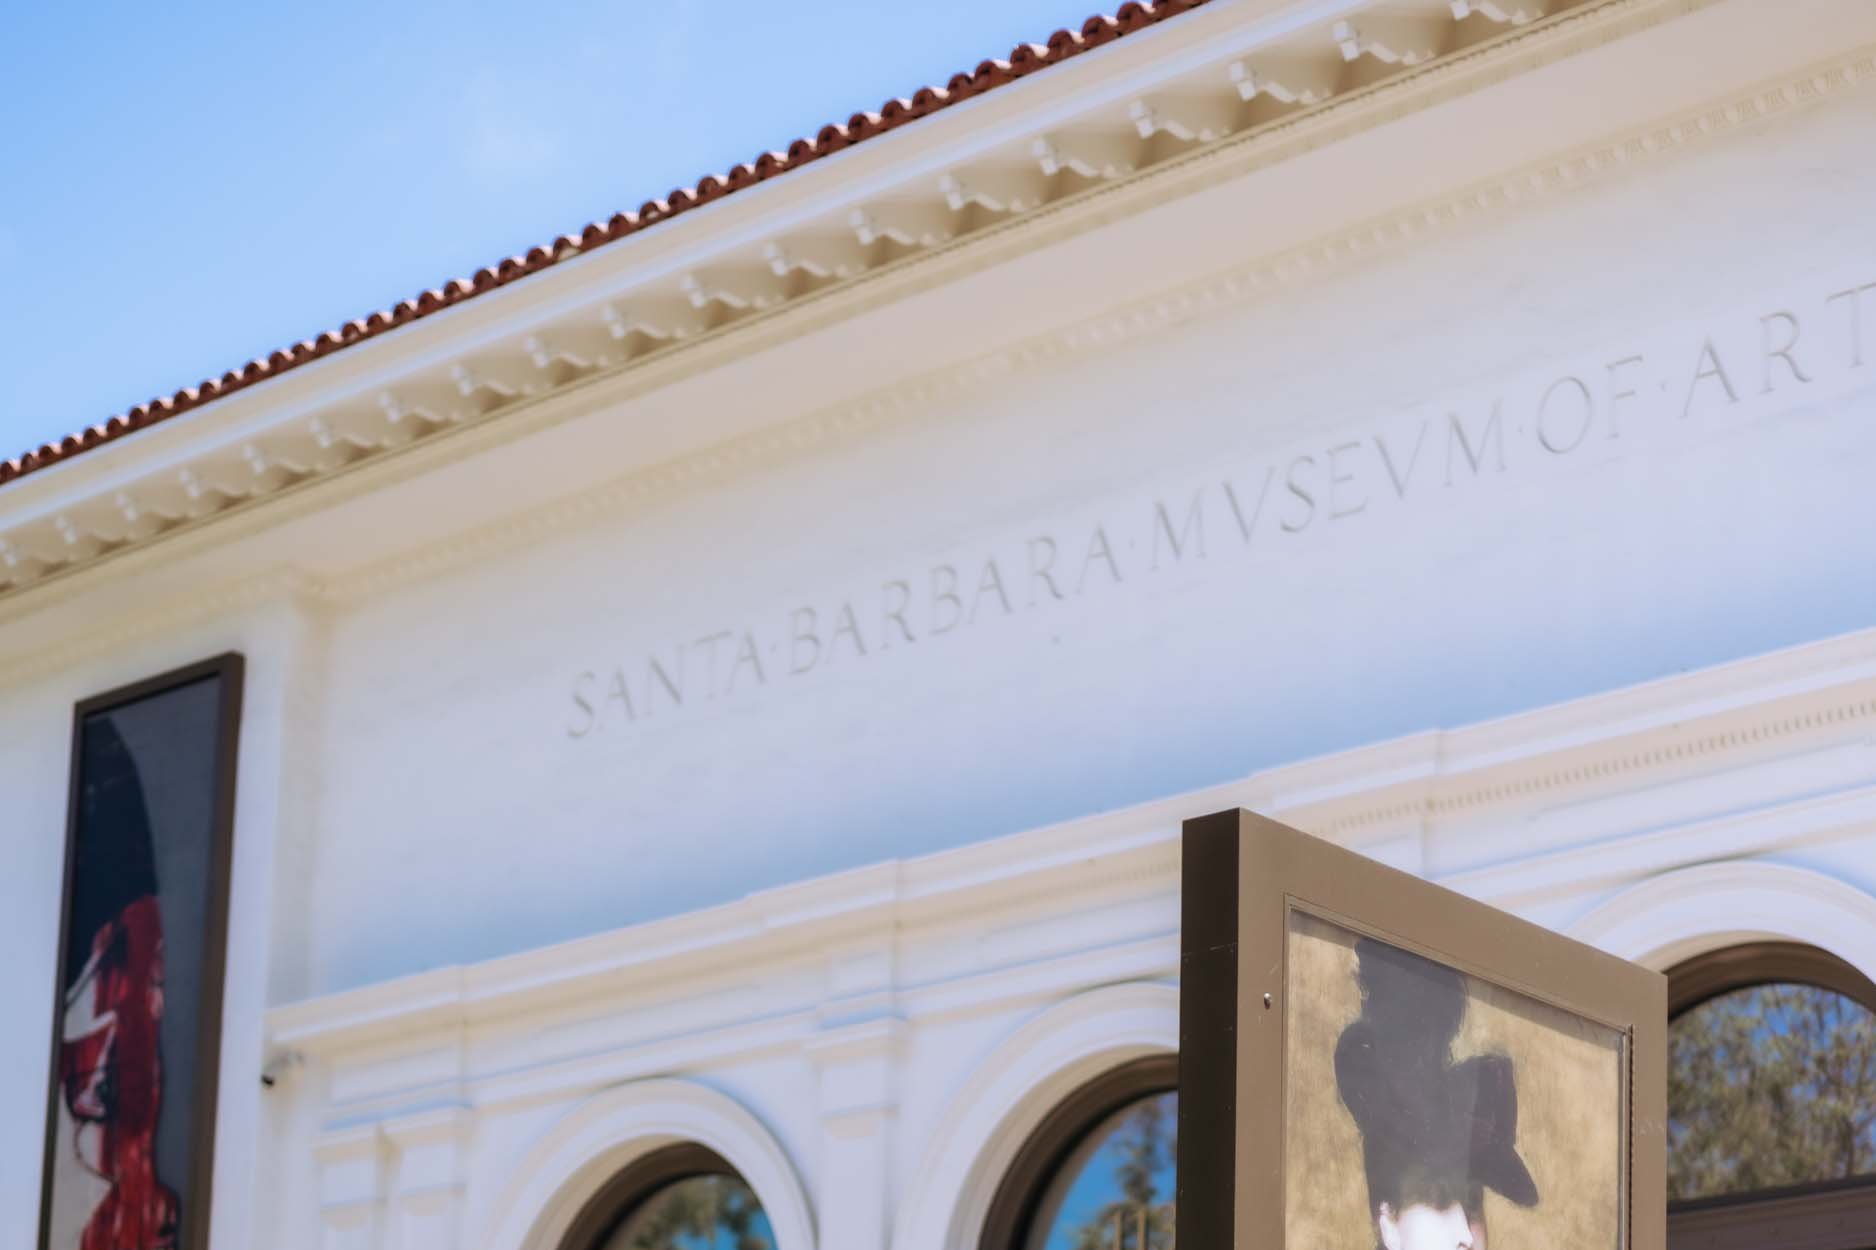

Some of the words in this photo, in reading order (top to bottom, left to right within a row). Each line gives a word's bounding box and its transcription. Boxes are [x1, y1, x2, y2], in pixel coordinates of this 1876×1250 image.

[564, 627, 770, 740] SANTA
[786, 521, 1124, 677] BARBARA
[1148, 396, 1508, 573] MVSEVM
[1536, 352, 1645, 456] OF
[1677, 281, 1876, 420] ART
